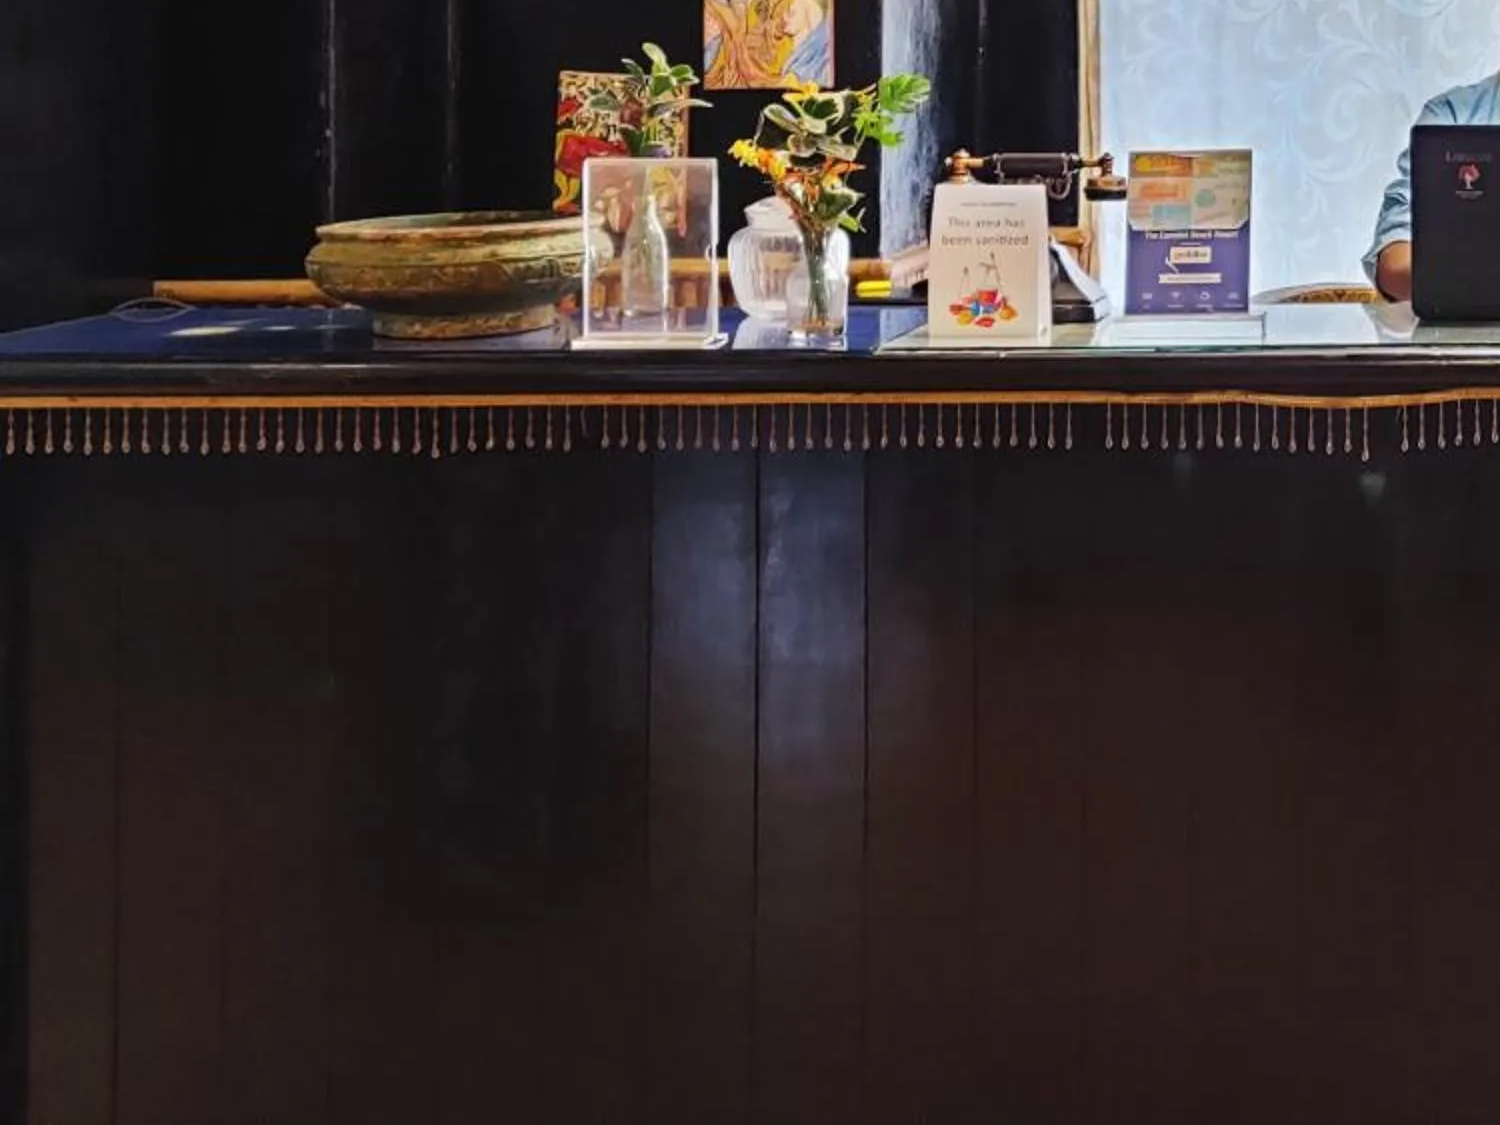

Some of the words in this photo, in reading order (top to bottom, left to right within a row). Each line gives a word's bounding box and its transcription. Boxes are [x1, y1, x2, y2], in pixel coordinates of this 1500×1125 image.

[948, 217, 970, 227] This
[977, 219, 1001, 227] area
[1005, 217, 1025, 227] has
[942, 234, 972, 245] been
[976, 234, 1029, 246] sanitized
